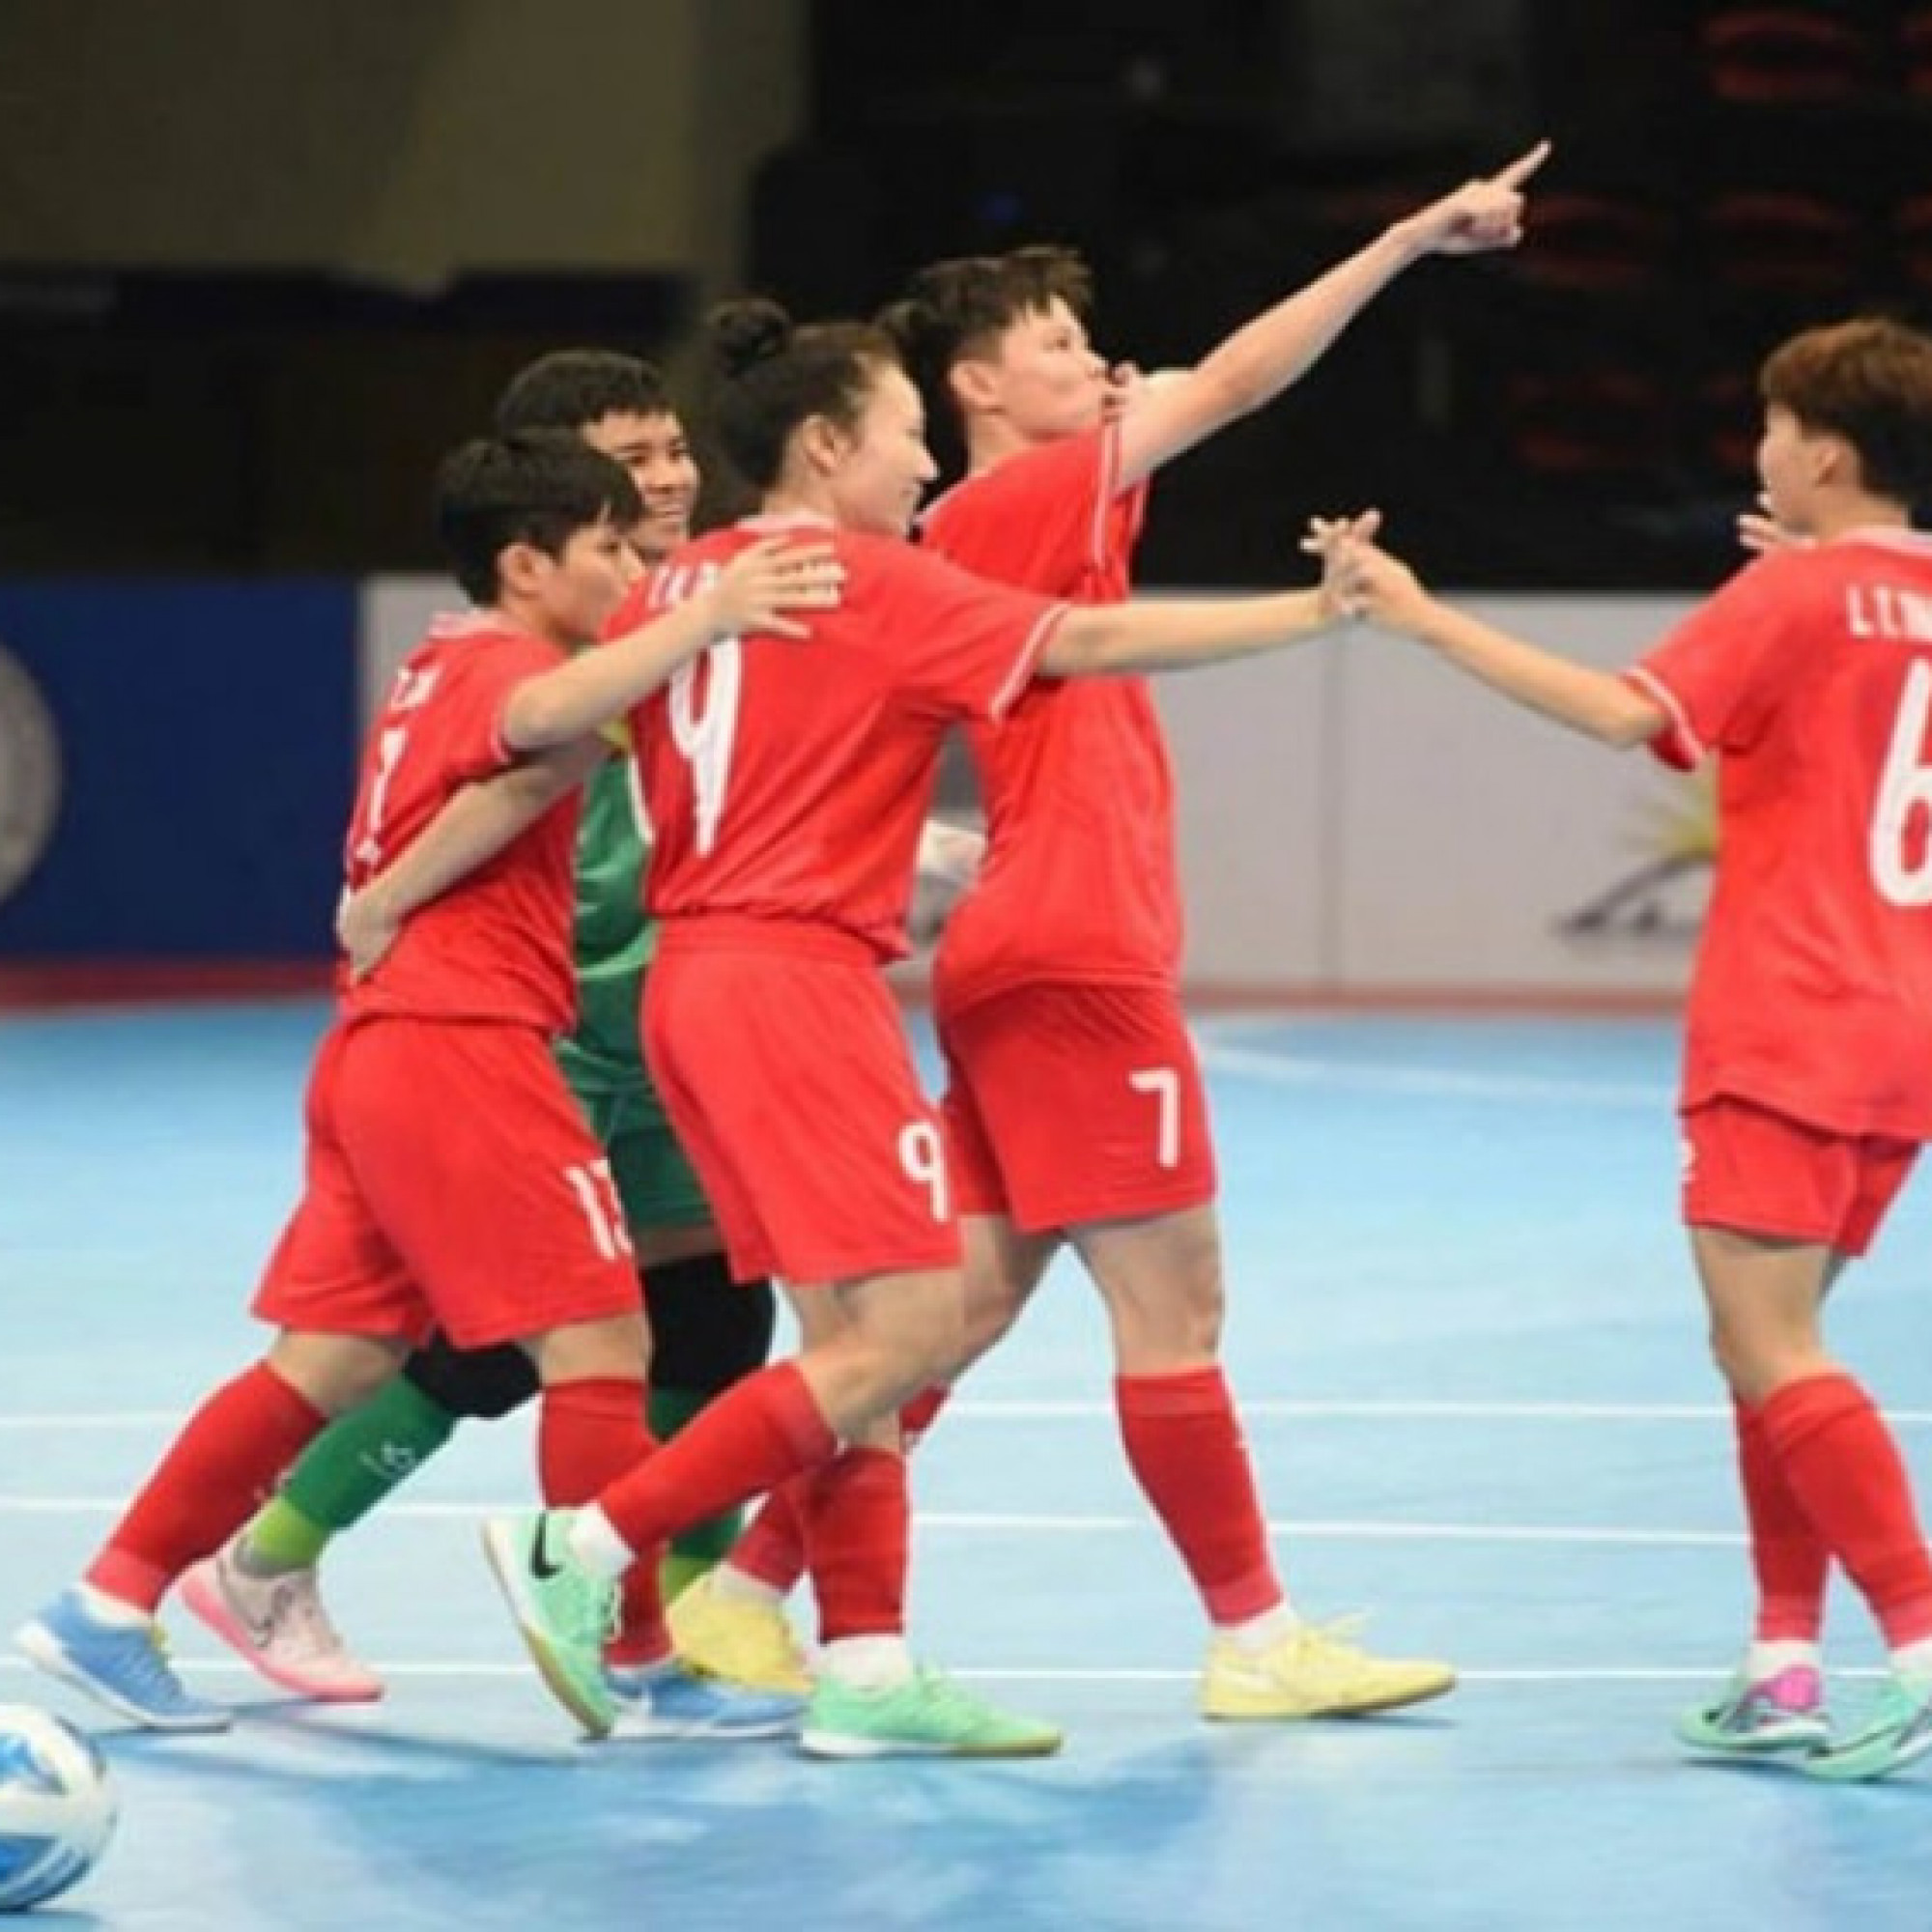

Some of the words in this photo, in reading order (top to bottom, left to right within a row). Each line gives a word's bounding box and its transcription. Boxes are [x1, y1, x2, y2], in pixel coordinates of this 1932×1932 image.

[669, 636, 742, 857] 9
[1870, 658, 1932, 906] 6
[898, 1122, 949, 1223] 9
[1130, 1068, 1179, 1168] 7
